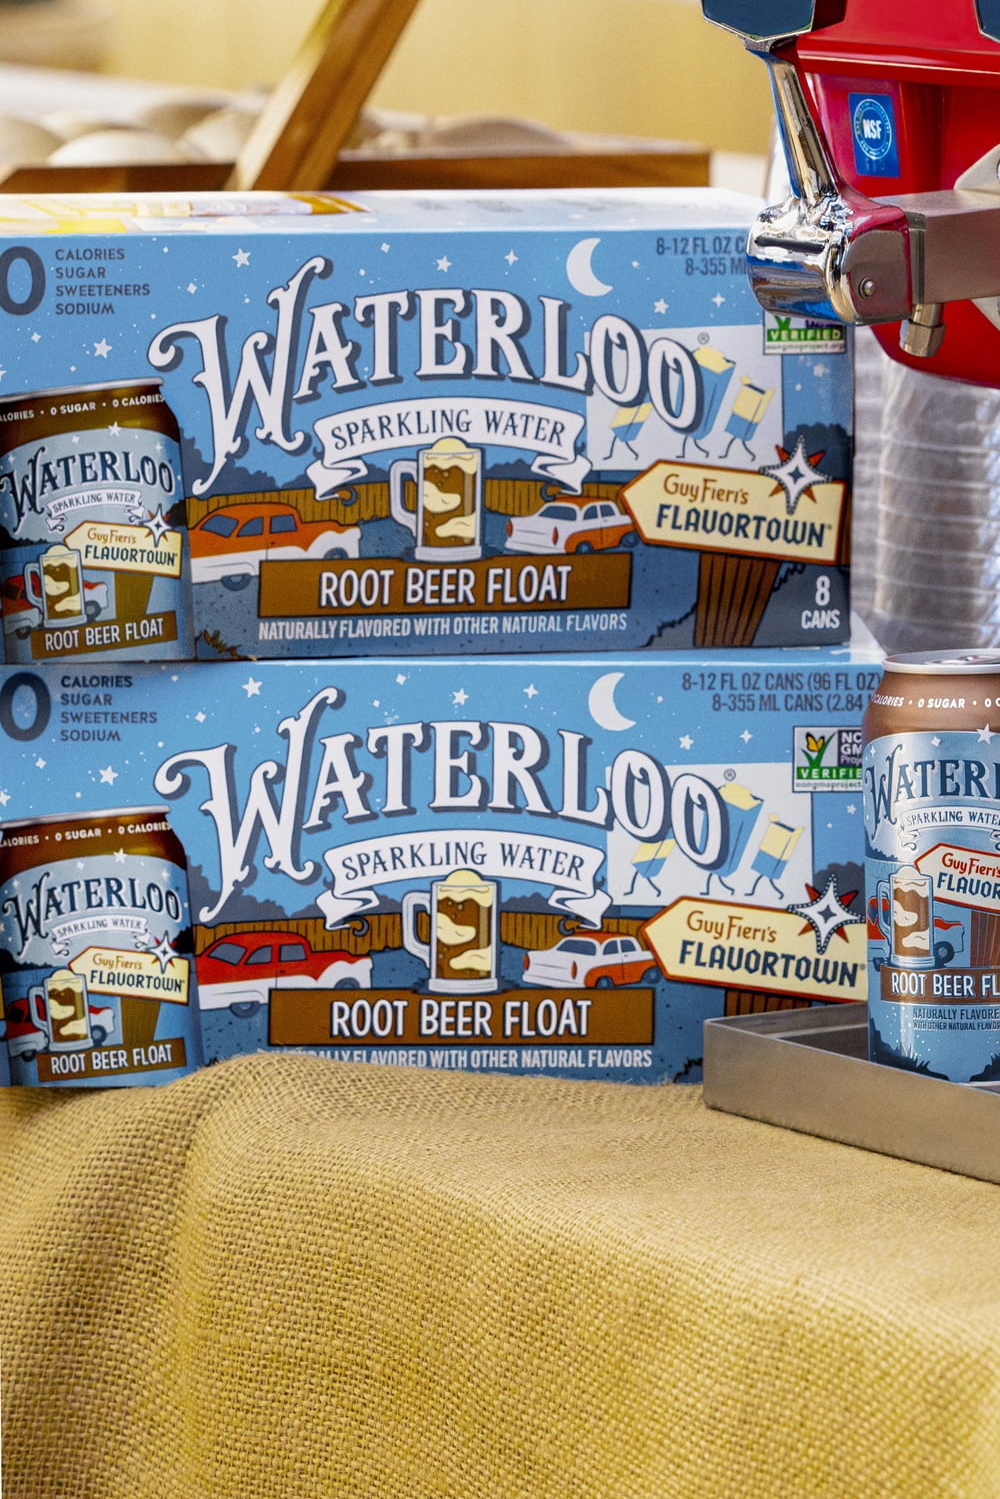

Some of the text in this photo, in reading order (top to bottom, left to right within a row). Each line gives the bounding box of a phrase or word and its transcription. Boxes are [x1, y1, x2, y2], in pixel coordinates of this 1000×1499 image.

[863, 118, 882, 139] NSF
[55, 248, 125, 261] CALORIES
[656, 237, 688, 255] 8-12
[693, 237, 707, 253] FL
[713, 237, 731, 253] OZ
[55, 266, 106, 279] SUGAR
[685, 258, 726, 275] 8-355
[55, 283, 151, 297] SWEETENERS
[55, 302, 115, 315] SODIUM
[769, 329, 842, 342] VERIFIED
[148, 255, 701, 495] WATERLOO
[50, 407, 57, 416] 0
[60, 402, 96, 414] SUGAR
[112, 400, 119, 408] 0
[331, 408, 566, 450] SPARKLING WATER
[0, 446, 175, 533] WATERLOO
[663, 473, 700, 502] Guy
[52, 492, 136, 514] SPARKLING WATER
[319, 564, 572, 608] ROOT BEER FLOAT
[815, 575, 831, 607] 8
[258, 613, 627, 641] NATURALLY FLAVORED WITH OTHER NATURAL FLAVORS
[801, 610, 840, 630] CANS
[45, 618, 164, 652] ROOT BEER FLOAT
[60, 675, 133, 689] CALORIES
[682, 672, 717, 691] 8-12
[721, 672, 738, 690] FL
[742, 672, 761, 690] OZ
[765, 672, 804, 690] CANS
[808, 672, 832, 692] (96
[836, 672, 853, 690] FL
[0, 672, 52, 742] 0
[60, 693, 113, 707] SUGAR
[712, 693, 756, 712] 8-355
[759, 694, 781, 711] ML
[784, 693, 823, 712] CANS
[827, 693, 863, 713] (2.84
[918, 698, 924, 708] 0
[927, 698, 965, 709] SUGAR
[984, 698, 991, 707] 0
[60, 711, 158, 725] SWEETENERS
[60, 729, 121, 742] SODIUM
[801, 768, 862, 779] VERIFIE
[153, 686, 728, 922] WATERLOO
[906, 810, 963, 826] SPARKLING
[55, 832, 62, 841] 0
[65, 828, 101, 840] SUGAR
[118, 826, 125, 835] 0
[342, 840, 584, 882] SPARKLING WATER
[942, 853, 968, 871] Guy
[2, 871, 180, 956] WATERLOO
[57, 917, 142, 937] SPARKLING WATER
[686, 910, 725, 939] Guy
[891, 972, 926, 996] ROOT
[933, 973, 975, 997] BEER
[331, 998, 592, 1038] ROOT BEER FLOAT
[913, 1008, 957, 1020] NATURALLY
[928, 1022, 947, 1031] OTHER
[948, 1022, 976, 1031] NATURAL
[51, 1044, 172, 1074] ROOT BEER FLOAT
[353, 1050, 427, 1067] FLAVORED
[429, 1050, 467, 1068] WITH
[471, 1049, 519, 1068] OTHER
[521, 1049, 585, 1068] NATURAL
[587, 1049, 652, 1068] FLAVORS
